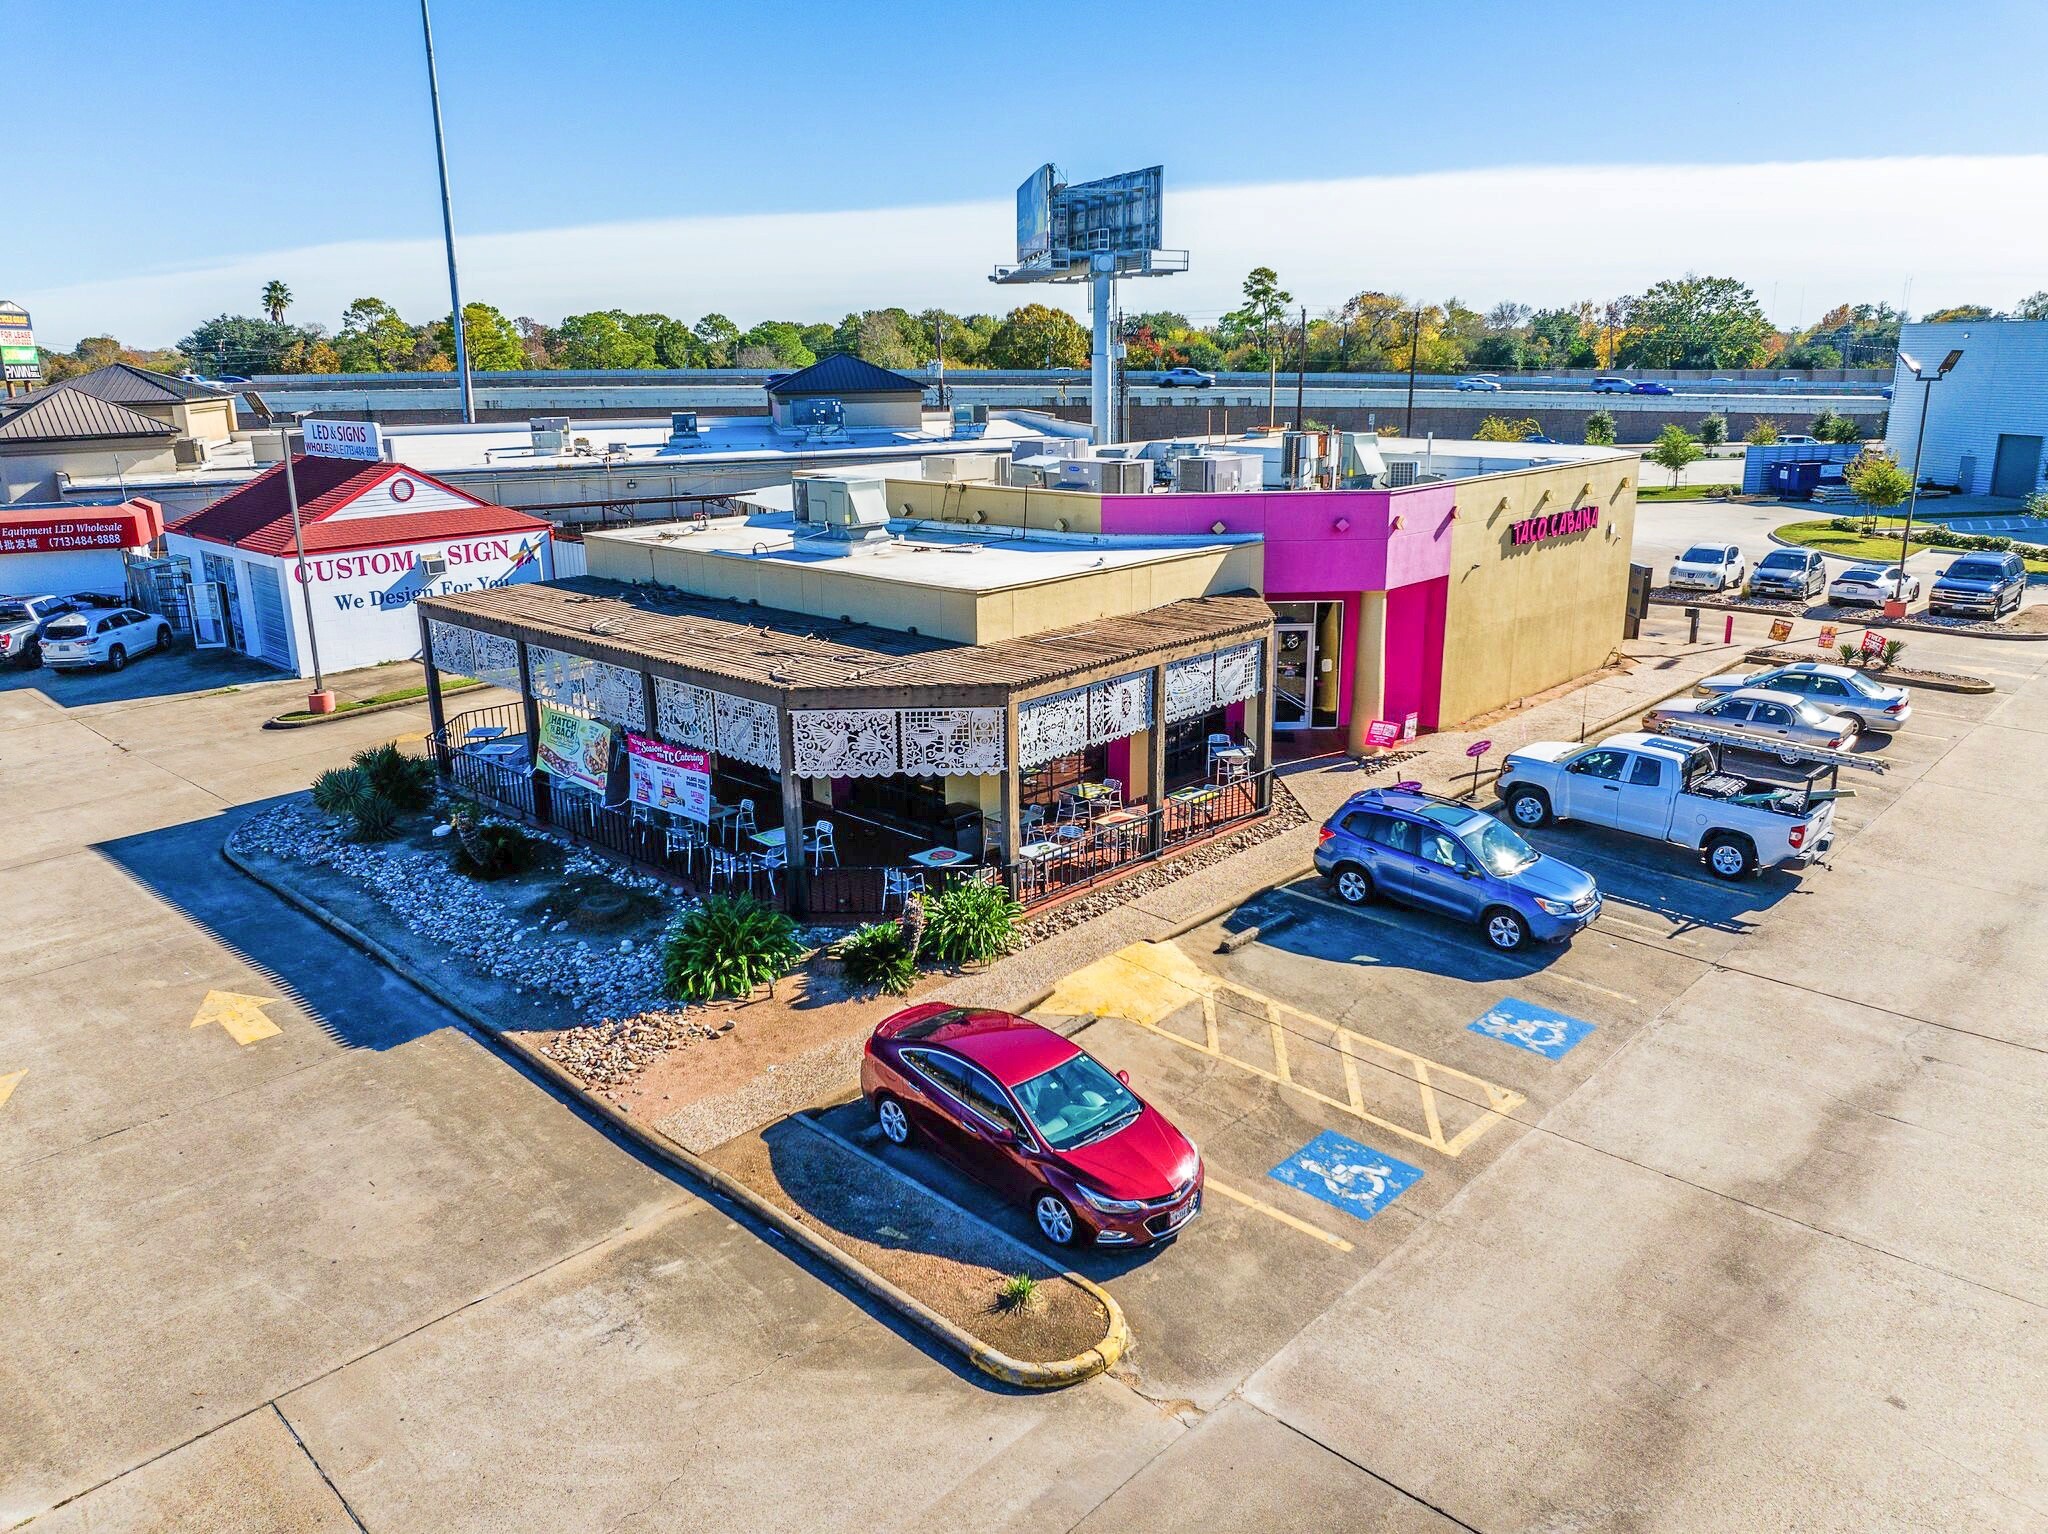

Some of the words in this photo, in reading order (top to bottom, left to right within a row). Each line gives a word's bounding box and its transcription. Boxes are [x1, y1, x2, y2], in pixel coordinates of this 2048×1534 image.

[0, 330, 12, 338] FOR
[13, 331, 31, 339] LEASE
[6, 365, 31, 378] PAWN
[311, 424, 329, 440] LED
[330, 426, 337, 440] &
[336, 426, 367, 443] SIGNS
[304, 441, 344, 455] WHOLESALE
[2, 526, 53, 538] Equipment
[54, 524, 74, 534] LED
[76, 522, 123, 532] Wholesale
[1511, 516, 1548, 547] TACO
[1548, 506, 1599, 537] CABANA
[48, 534, 121, 547] (713)484-8888
[294, 550, 416, 584] CUSTOM
[447, 539, 510, 566] SIGN
[333, 594, 364, 611] We
[369, 586, 434, 607] Design
[440, 579, 473, 596] For
[551, 715, 577, 730] HATCH
[555, 726, 576, 740] BACK
[663, 750, 675, 763] TC
[674, 750, 704, 766] Catering
